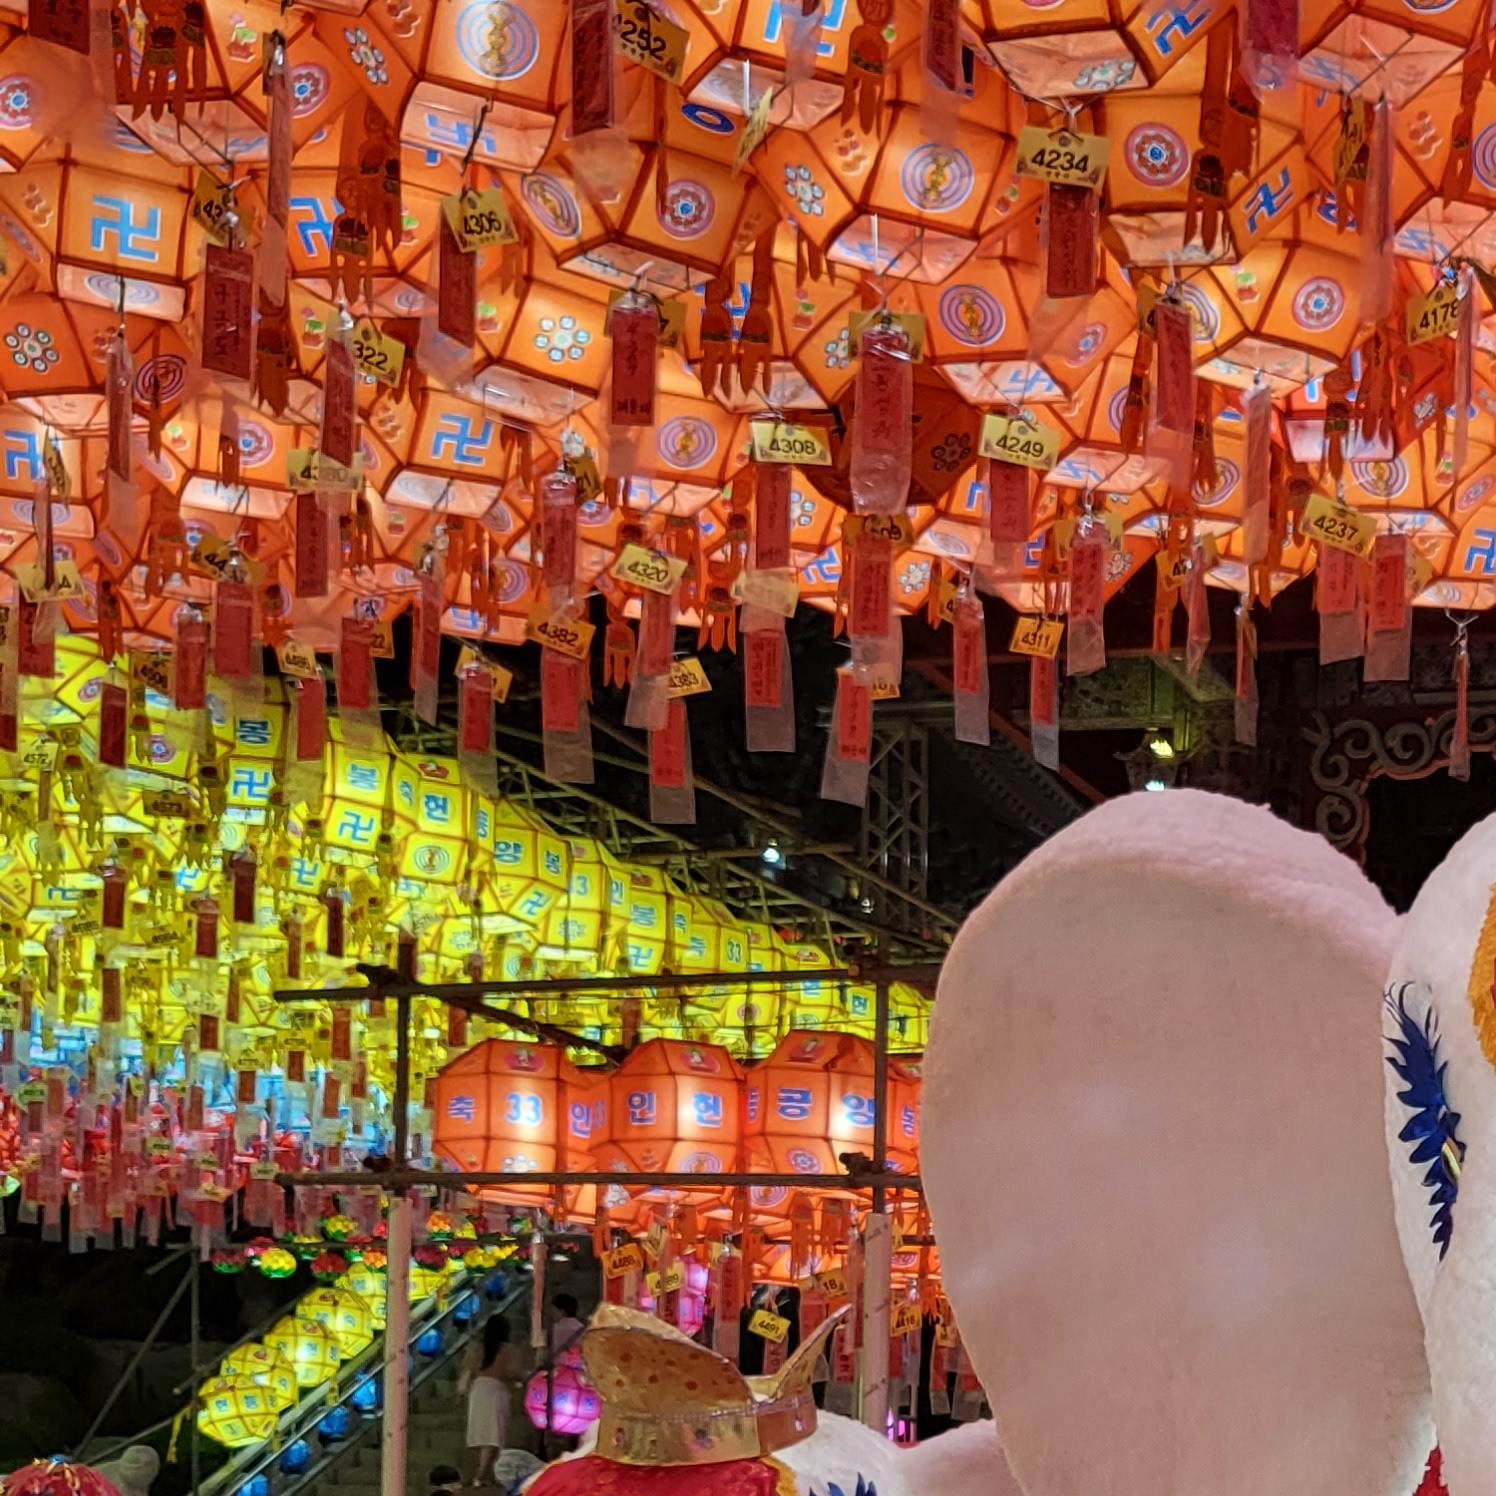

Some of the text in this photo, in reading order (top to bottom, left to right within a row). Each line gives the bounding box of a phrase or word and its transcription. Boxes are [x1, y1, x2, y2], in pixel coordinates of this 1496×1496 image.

[616, 15, 666, 60] 252
[1031, 148, 1088, 172] 4234
[464, 213, 501, 236] 4306
[1420, 303, 1458, 331] 4178
[353, 341, 388, 372] 322
[769, 440, 817, 456] 4308
[995, 436, 1043, 459] 4249
[1313, 515, 1359, 540] 4237
[627, 559, 668, 583] 4320
[536, 621, 578, 647] 4382
[1020, 631, 1049, 649] 4311
[506, 1092, 543, 1124] 33
[654, 1275, 678, 1289] 489
